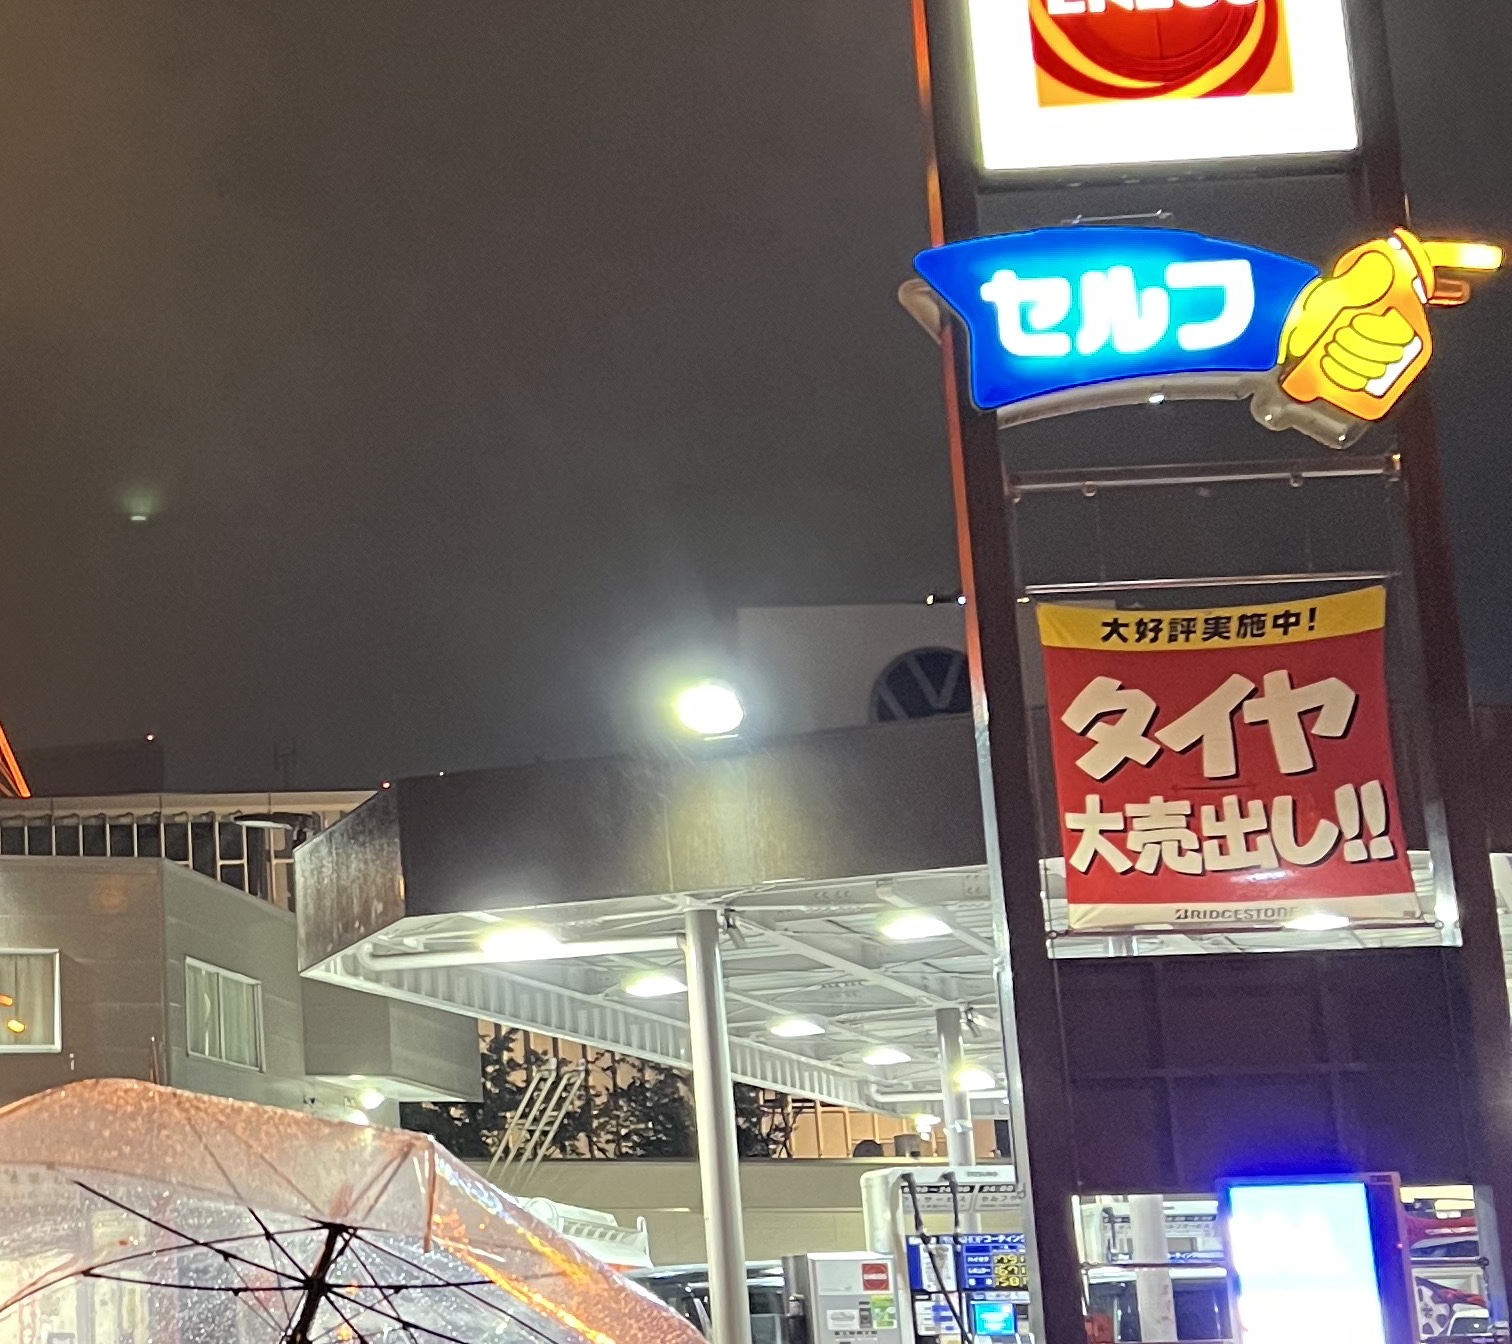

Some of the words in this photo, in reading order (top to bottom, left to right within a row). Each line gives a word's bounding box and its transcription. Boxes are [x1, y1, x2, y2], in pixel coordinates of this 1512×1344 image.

[980, 257, 1257, 359] セルフ
[1100, 607, 1317, 644] 大好評実施中!
[1060, 669, 1358, 781] タイヤ
[1065, 779, 1395, 876] 大売出し!!
